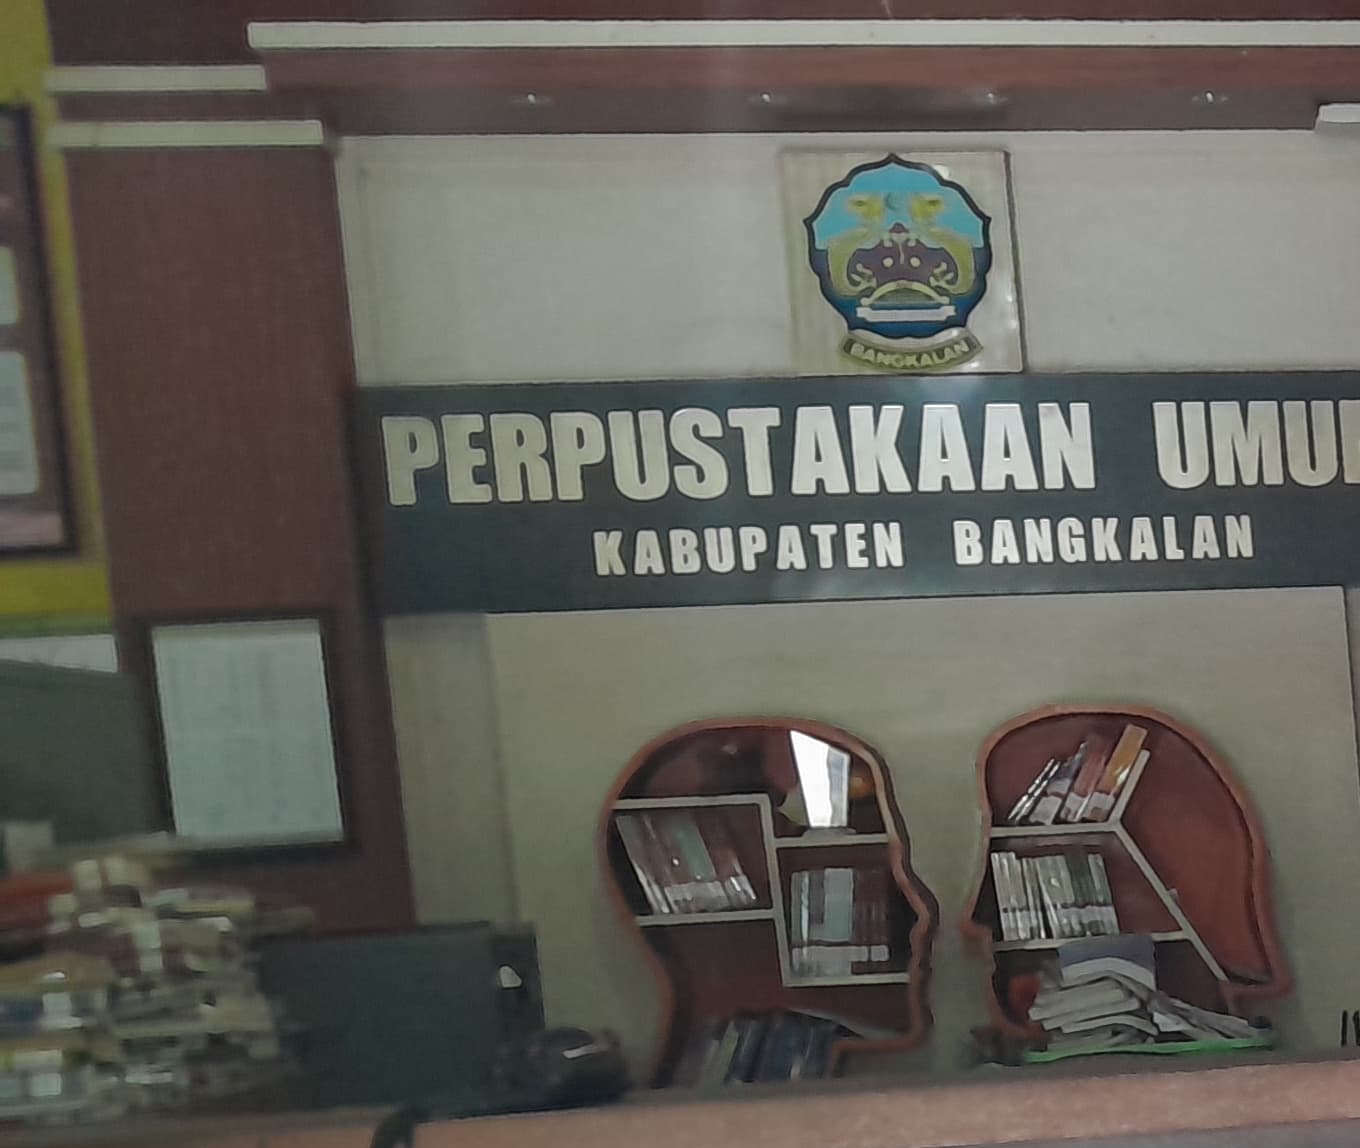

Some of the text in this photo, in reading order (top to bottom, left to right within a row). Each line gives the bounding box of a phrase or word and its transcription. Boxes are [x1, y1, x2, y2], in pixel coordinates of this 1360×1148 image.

[849, 339, 970, 368] BANGKALAN
[380, 401, 1097, 506] PERPUSTAKAAN
[593, 514, 1256, 578] KABUPATEN BANGKALAN
